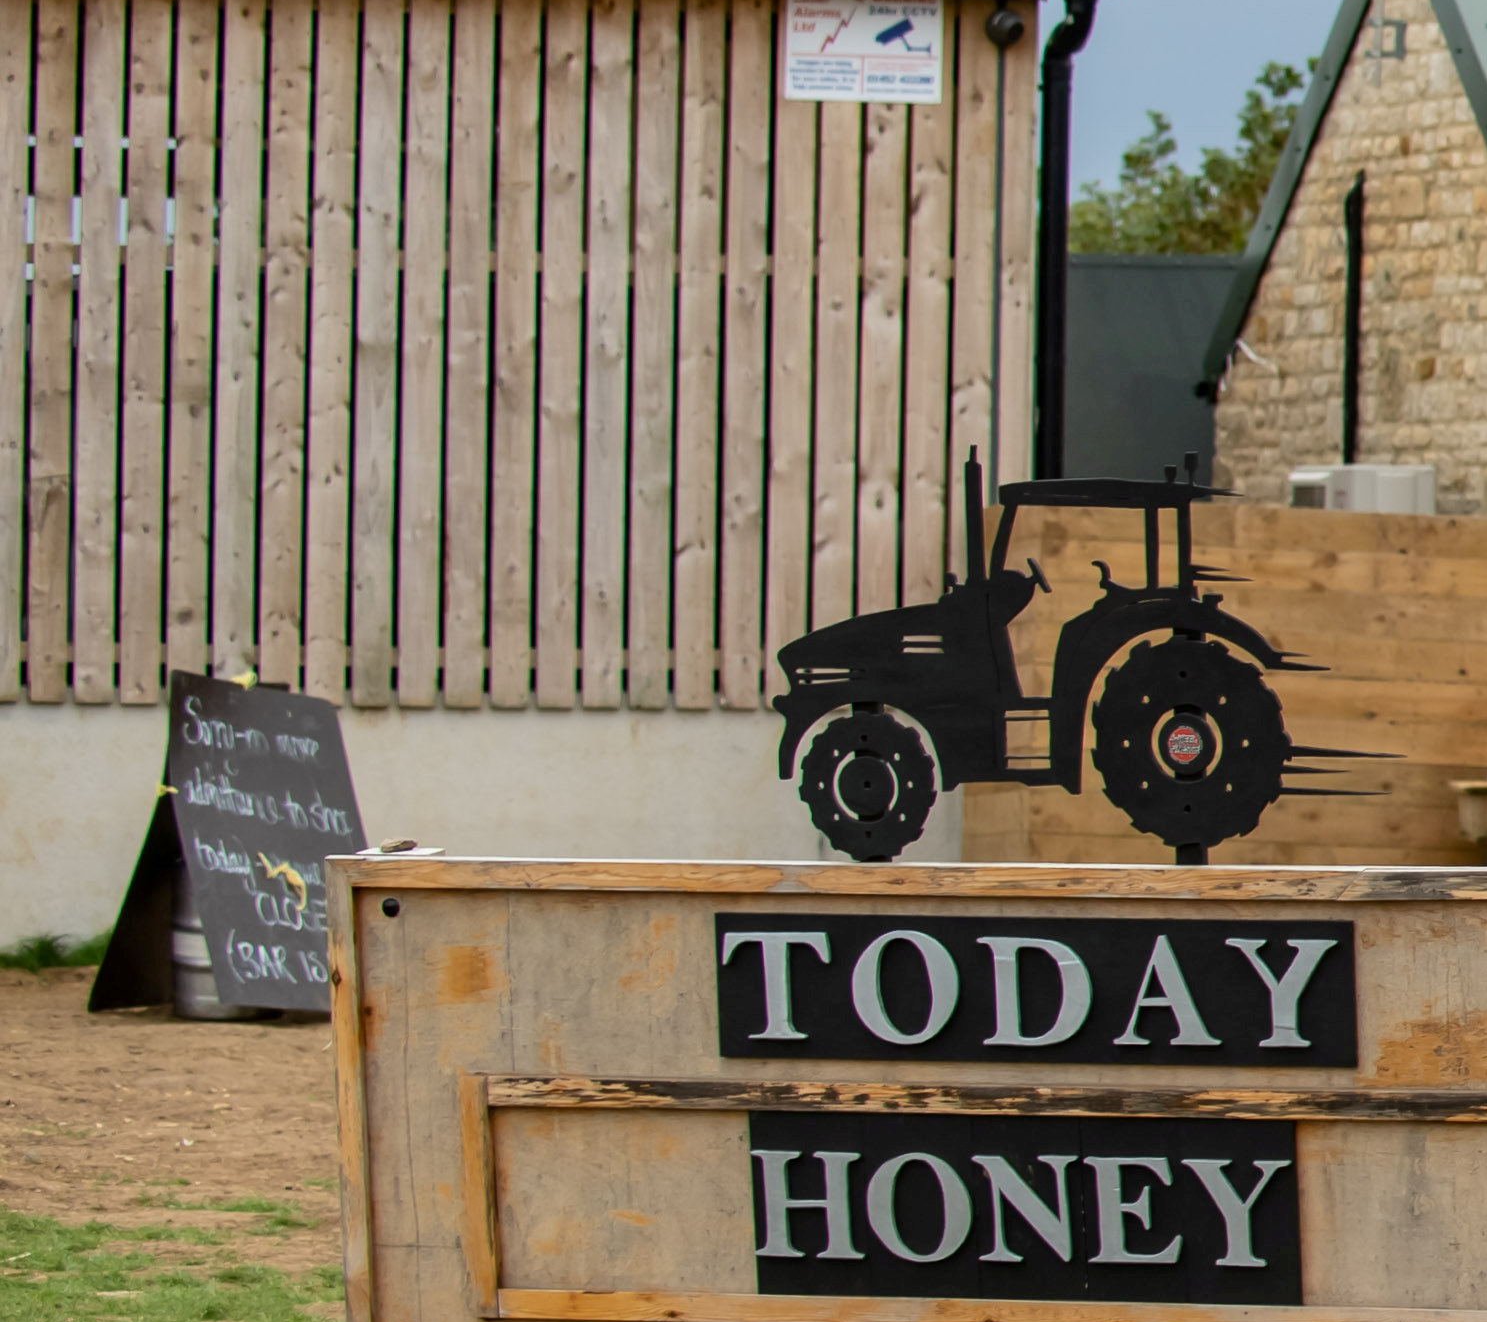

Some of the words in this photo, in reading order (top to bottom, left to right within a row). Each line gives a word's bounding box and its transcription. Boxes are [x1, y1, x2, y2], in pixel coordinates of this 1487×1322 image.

[793, 21, 816, 32] Ltd
[901, 6, 938, 17] CCTV
[721, 930, 1338, 1049] TODAY
[752, 1150, 1293, 1270] HONEY
